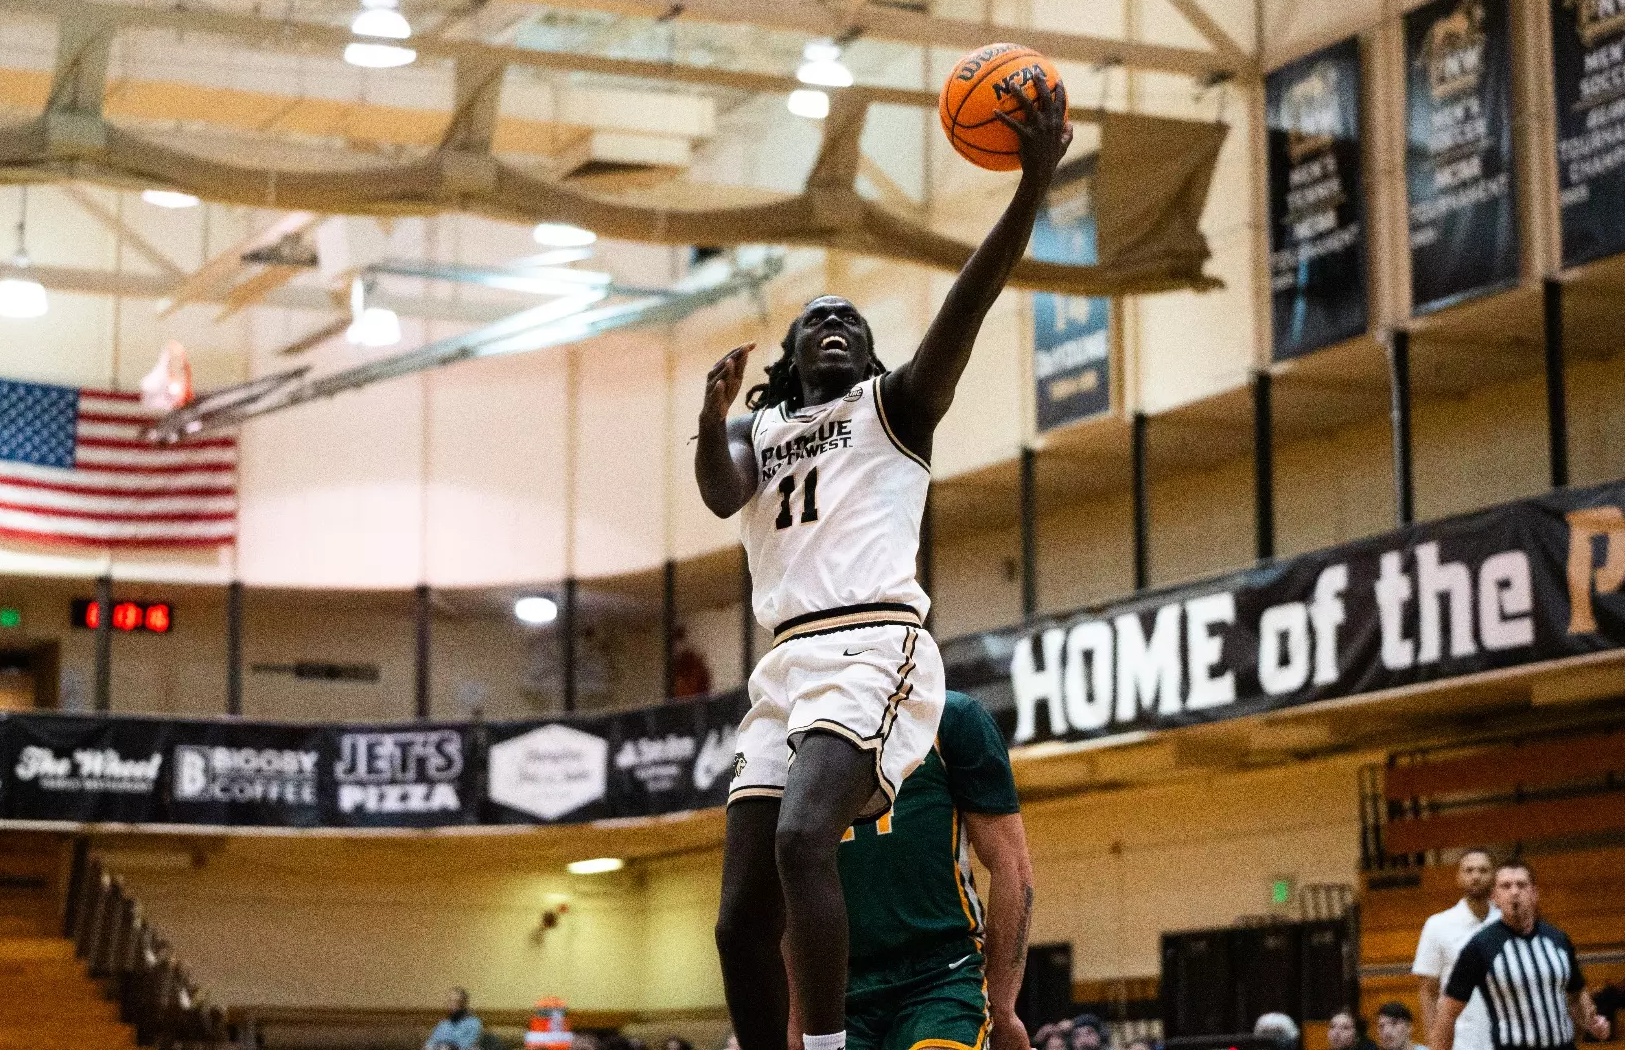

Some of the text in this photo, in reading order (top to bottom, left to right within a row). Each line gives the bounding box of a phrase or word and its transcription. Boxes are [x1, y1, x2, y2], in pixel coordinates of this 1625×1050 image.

[992, 64, 1047, 101] NCAA
[1580, 65, 1625, 99] SOCC
[1558, 124, 1625, 161] TOURNA
[761, 437, 853, 482] NOTHWEST
[775, 465, 819, 530] 11
[1011, 505, 1625, 743] HOME of the P
[333, 730, 464, 781] JET'S
[338, 782, 461, 813] PIZZA
